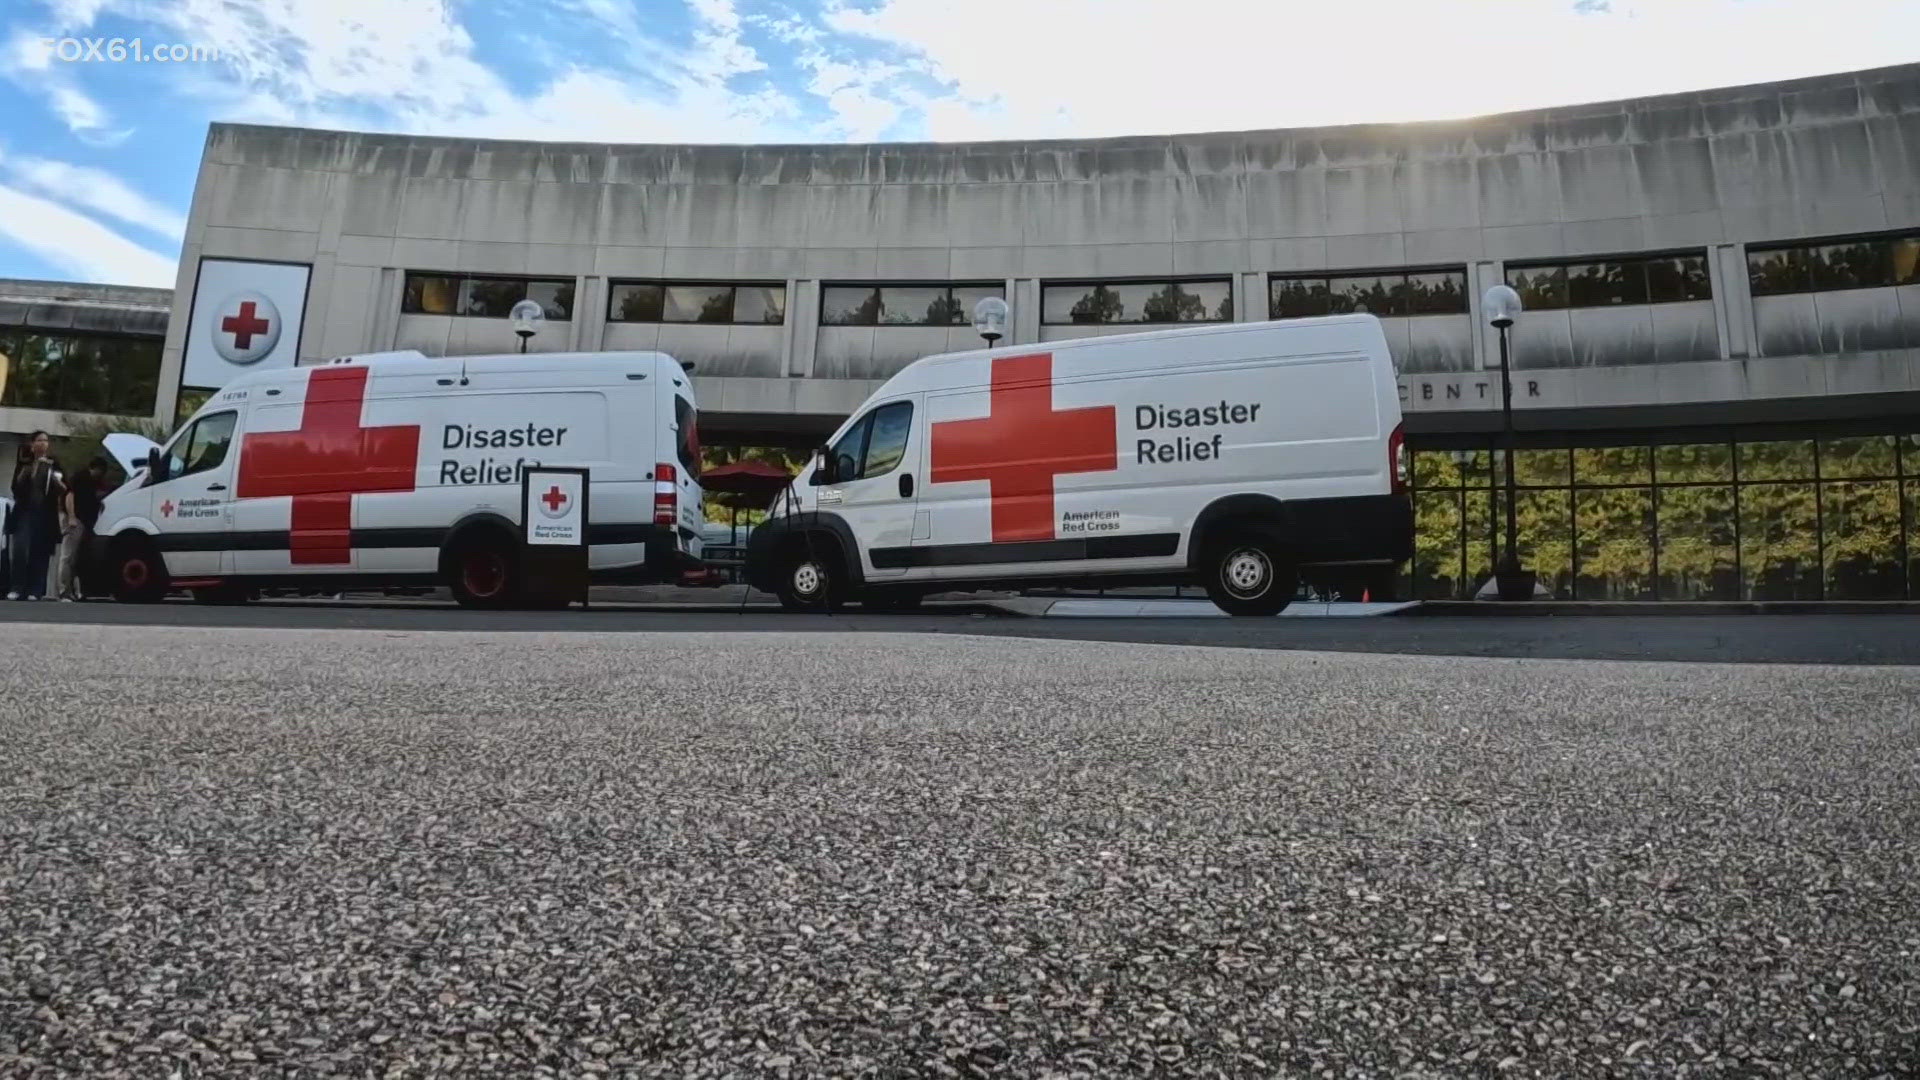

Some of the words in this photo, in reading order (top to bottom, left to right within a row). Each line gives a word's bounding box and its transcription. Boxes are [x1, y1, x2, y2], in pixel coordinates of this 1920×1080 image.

[1398, 381, 1541, 401] CENTR
[1135, 399, 1260, 431] Disaster
[442, 422, 568, 450] Disaster
[1136, 434, 1223, 464] Relief
[440, 457, 525, 485] Relief
[178, 509, 193, 518] Red
[195, 509, 219, 518] Cross
[1062, 510, 1120, 522] American
[1062, 523, 1085, 532] Red
[1087, 522, 1120, 531] Cross
